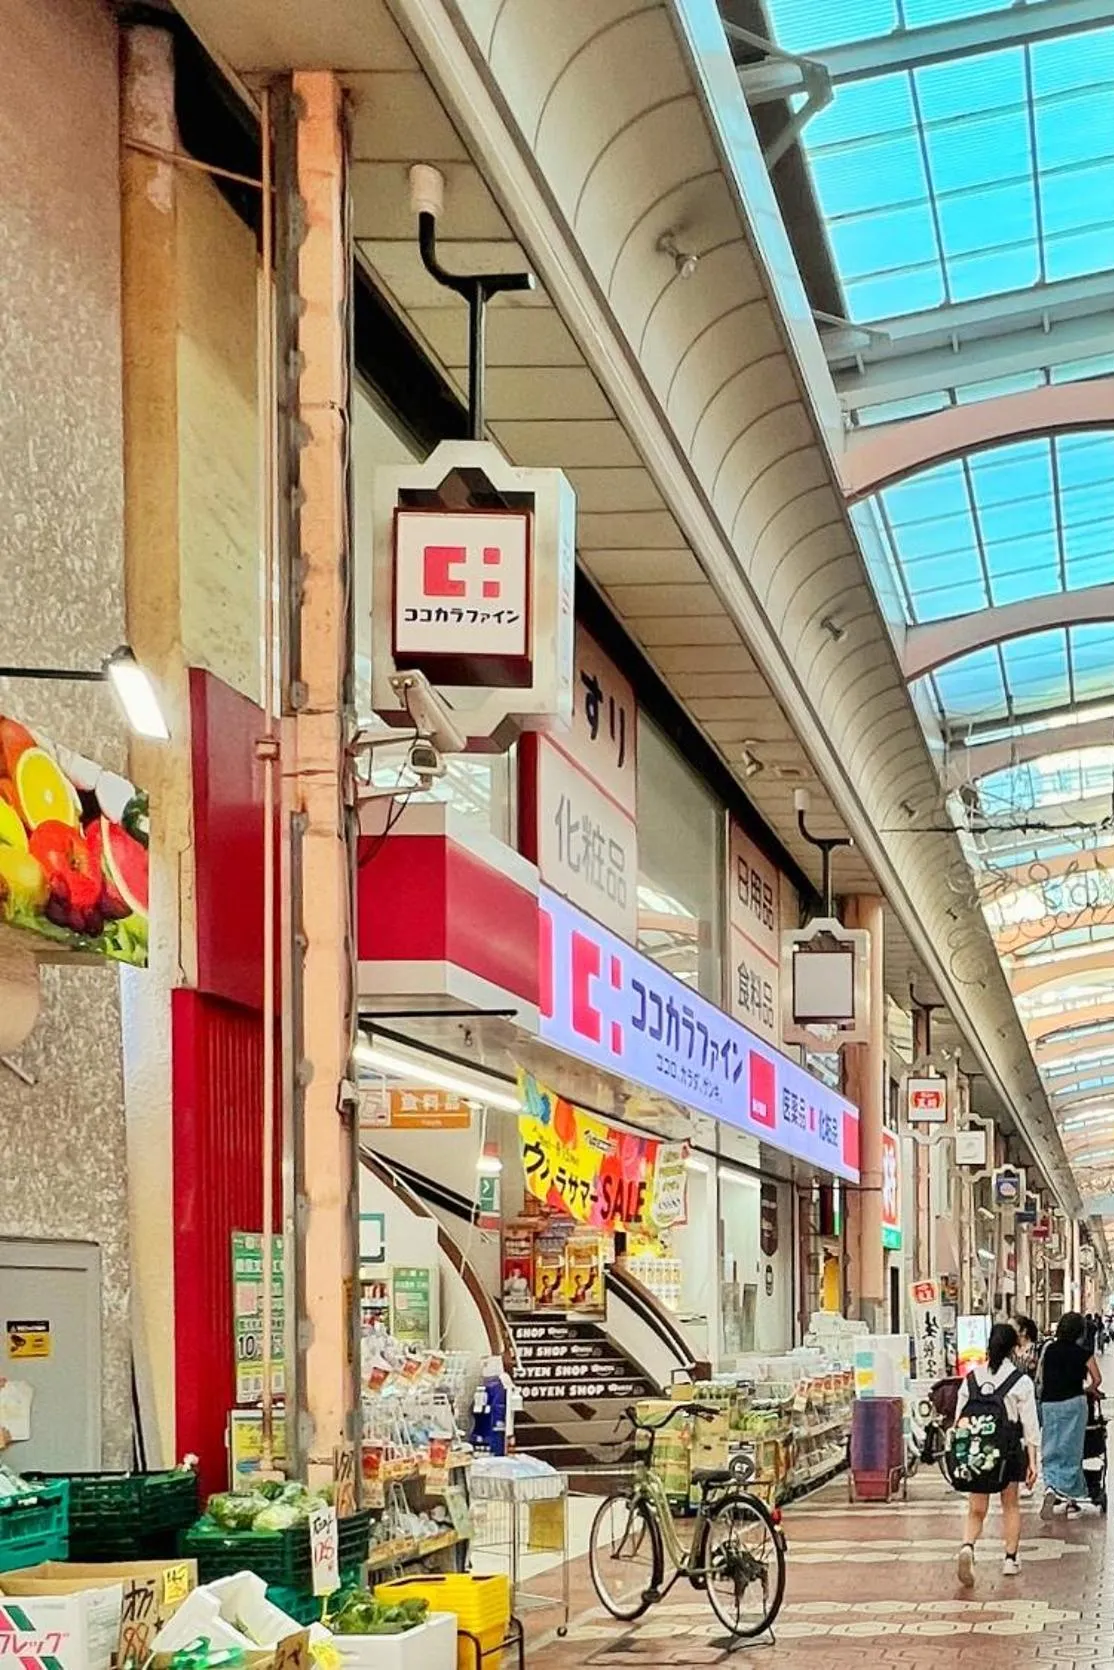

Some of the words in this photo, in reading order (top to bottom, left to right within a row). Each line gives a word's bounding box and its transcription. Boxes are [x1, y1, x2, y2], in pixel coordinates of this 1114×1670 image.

[404, 607, 520, 624] ココカラファイン
[554, 794, 628, 910] 化粧品
[737, 854, 775, 932] 日用品
[736, 960, 775, 1030] 食料品
[631, 977, 744, 1084] ココカラファイン
[600, 1175, 648, 1223] SALE
[516, 1327, 546, 1338] SHOP
[536, 1346, 568, 1357] SHOP
[554, 1365, 589, 1377] SHOP
[569, 1384, 605, 1396] SHOP
